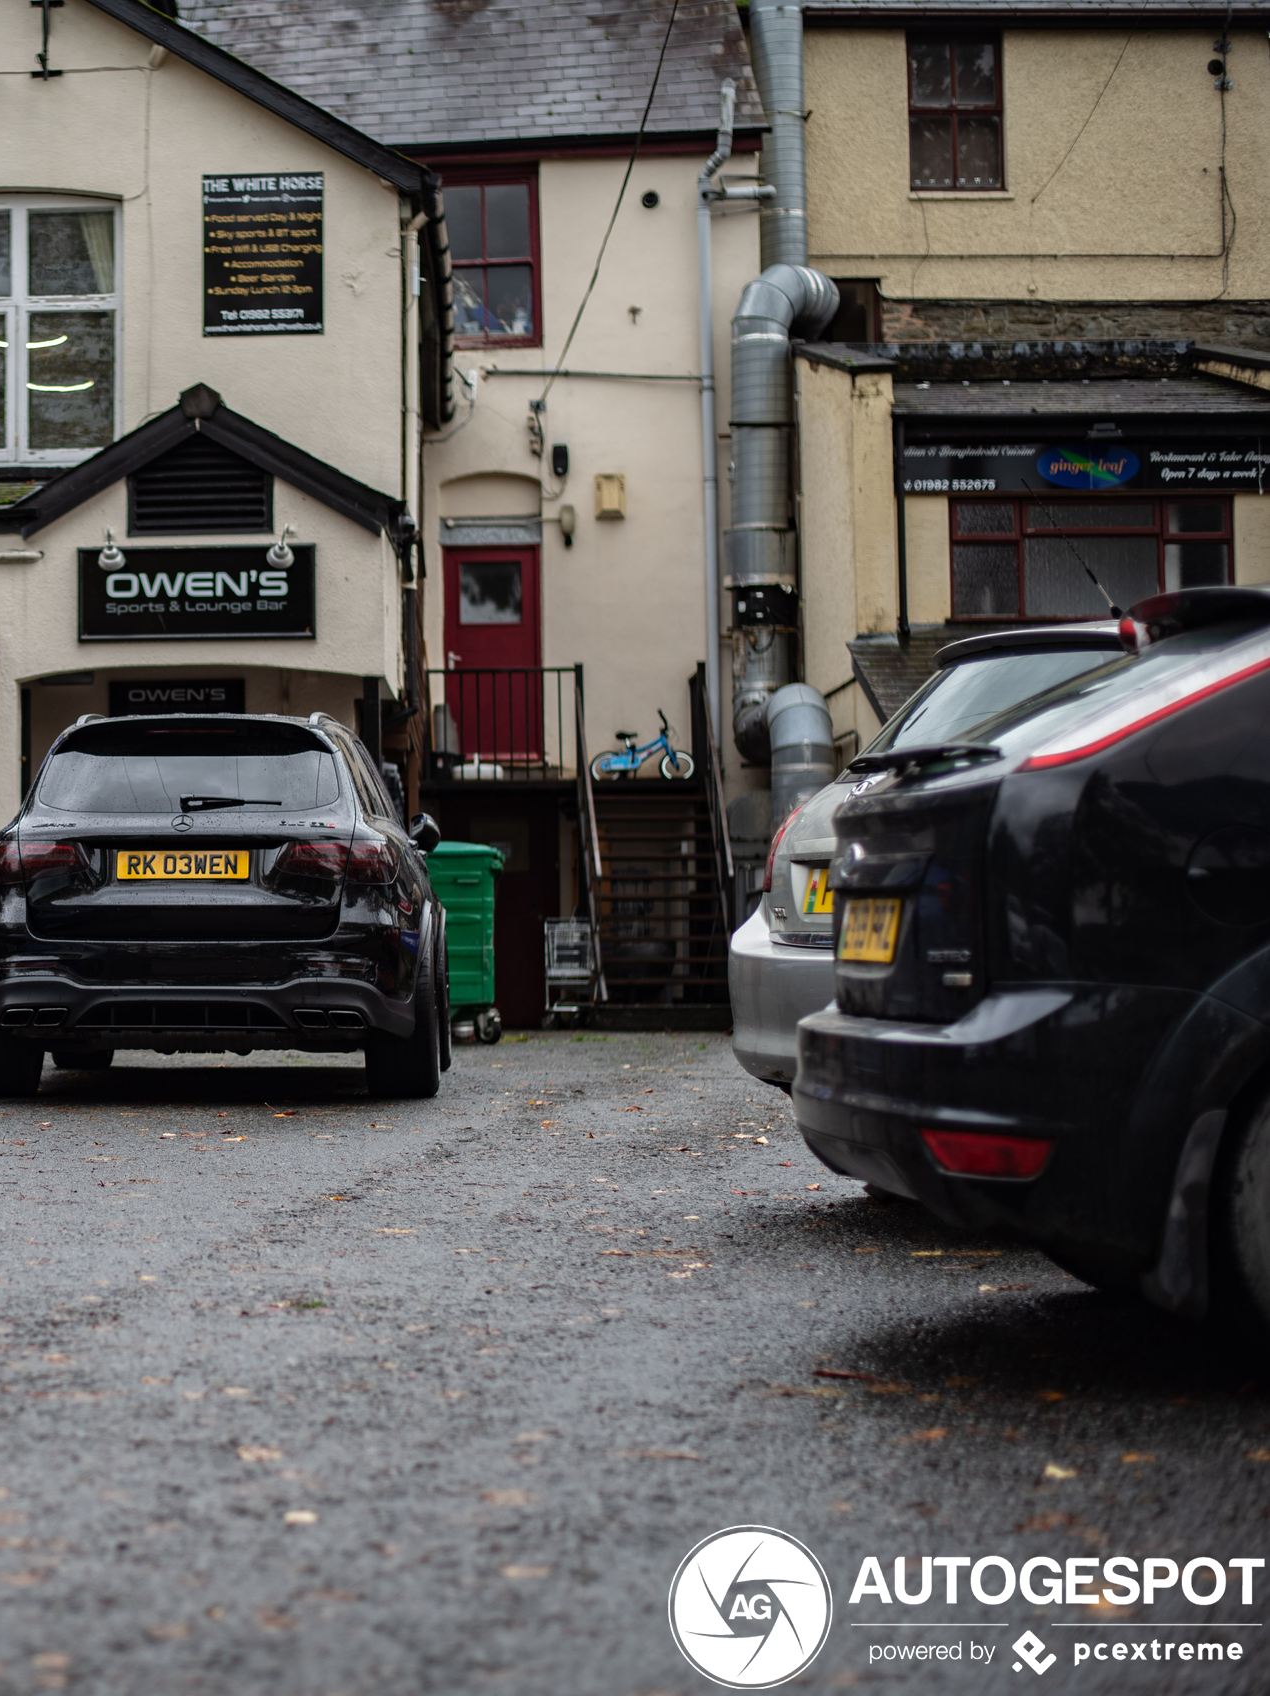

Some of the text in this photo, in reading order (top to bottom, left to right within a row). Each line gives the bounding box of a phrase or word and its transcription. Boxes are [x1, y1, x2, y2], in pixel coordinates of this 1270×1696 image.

[202, 176, 324, 192] THE WHITE HORSE
[210, 212, 323, 223] Food served Day & Night
[215, 229, 317, 240] Sky sports & BT sport
[210, 245, 232, 254] Free
[251, 244, 258, 253] &
[259, 244, 279, 253] USB
[281, 243, 323, 254] Charging
[231, 259, 304, 268] Accommodation
[237, 273, 296, 283] Beer Garden
[213, 286, 249, 296] Sunday
[251, 285, 280, 294] Lunch
[239, 309, 270, 320] 01982
[271, 308, 304, 319] 553171
[939, 445, 1000, 459] Bangladeshi
[1001, 445, 1036, 457] Cuisine
[1150, 451, 1205, 462] Restaurant
[1218, 451, 1243, 462] Take
[1049, 458, 1127, 475] ginger leaf
[1161, 467, 1186, 482] Open
[1187, 467, 1196, 478] 7
[1197, 467, 1220, 481] days
[1222, 470, 1231, 478] a
[914, 479, 949, 491] 01982
[951, 479, 996, 491] 552675
[106, 569, 289, 598] OWEN'S
[105, 600, 287, 616] Sports & Lounge Bar
[128, 688, 226, 702] OWEN'S
[127, 853, 238, 875] RK 03WEN
